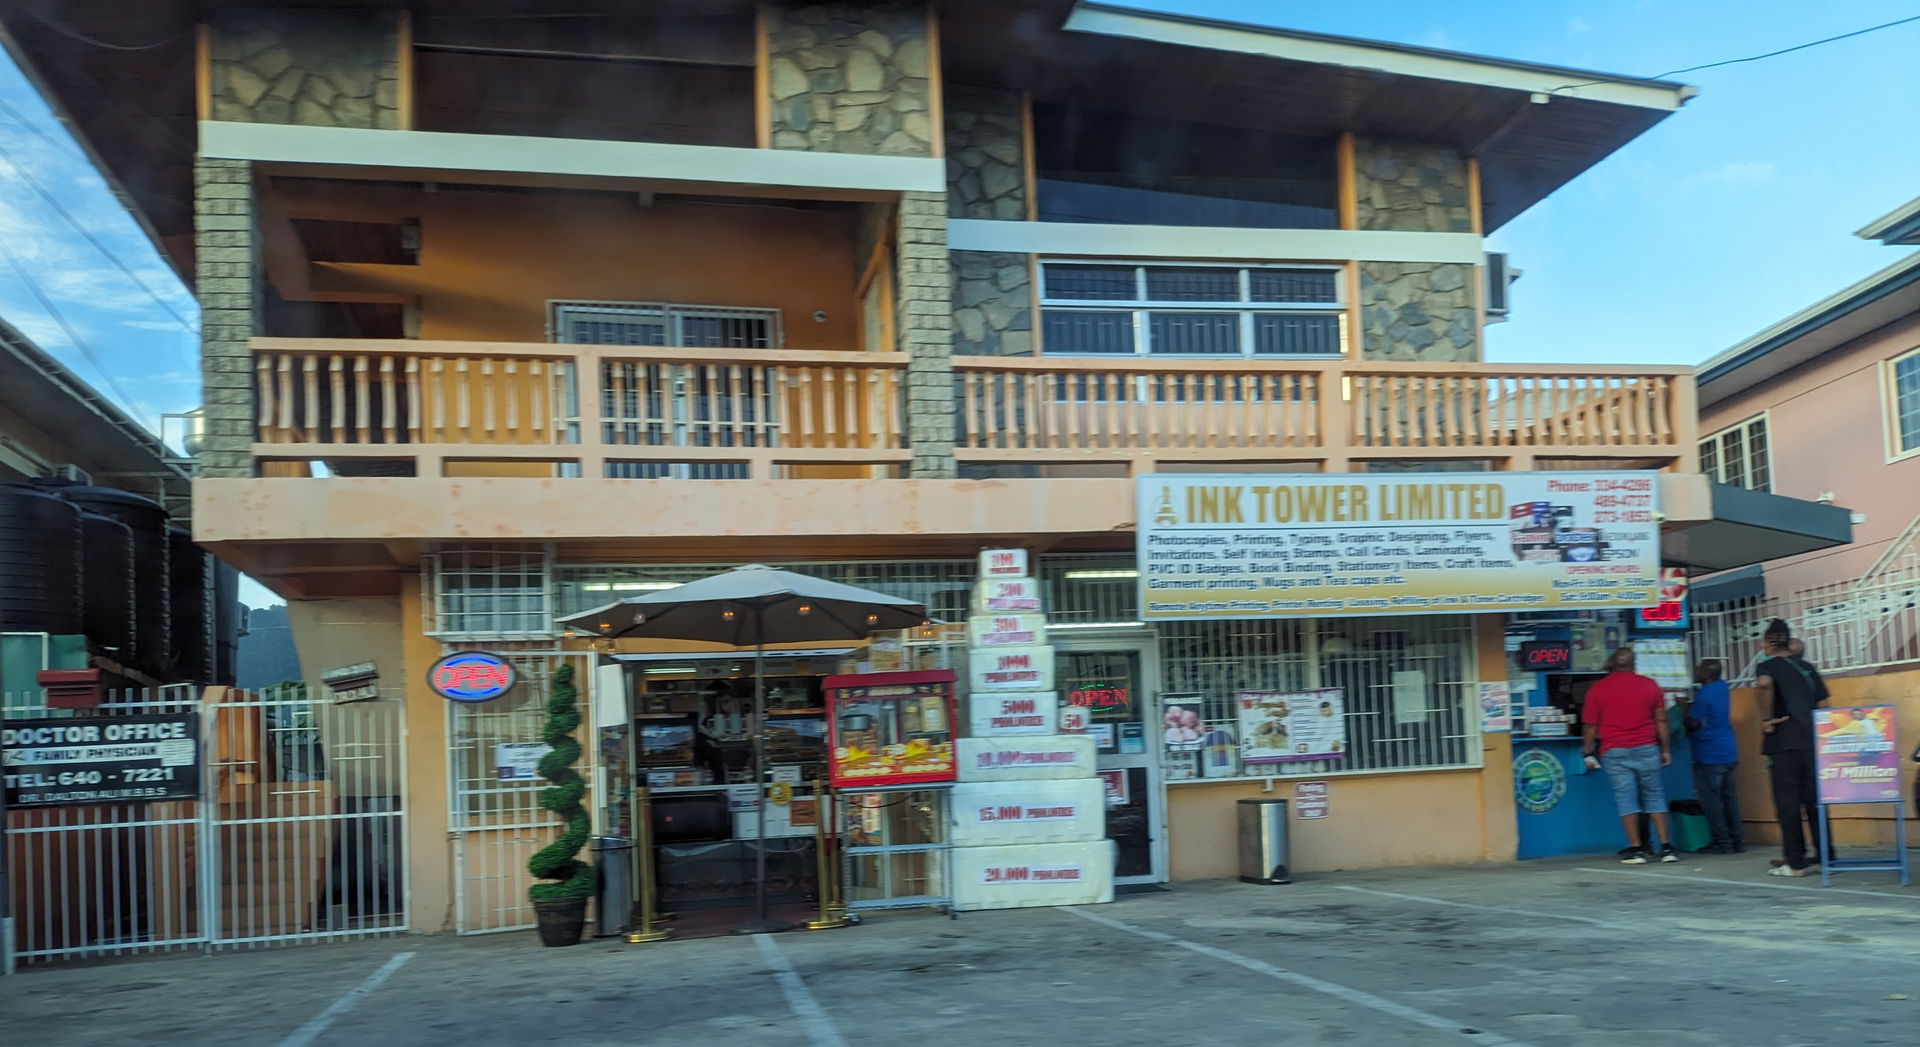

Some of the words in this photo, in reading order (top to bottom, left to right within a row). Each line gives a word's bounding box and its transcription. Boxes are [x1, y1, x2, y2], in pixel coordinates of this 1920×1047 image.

[1548, 480, 1590, 492] Phone:
[1186, 485, 1245, 524] INK
[1252, 484, 1369, 524] TOWER
[1379, 483, 1504, 521] LIMITED
[1149, 534, 1230, 546] Photocopies,
[1233, 534, 1285, 547] Printing,
[1289, 534, 1332, 546] Typing,
[1337, 533, 1384, 545] Graphic
[1389, 531, 1450, 545] Designing,
[1454, 530, 1495, 543] Flyers,
[1149, 549, 1218, 560] Invitations,
[1222, 549, 1248, 559] Self
[1251, 549, 1288, 561] Inking
[1293, 548, 1341, 560] Stamps,
[1345, 546, 1368, 557] Call
[1373, 546, 1411, 557] Cards,
[1414, 545, 1486, 557] Laminating,
[1148, 564, 1175, 575] PVC
[1178, 564, 1192, 574] ID
[1195, 564, 1245, 576] Badges,
[1249, 563, 1279, 573] Book
[1284, 562, 1332, 574] Binding,
[1337, 561, 1401, 572] Stationery
[1444, 559, 1474, 569] Craft
[1149, 579, 1204, 590] Garment
[1207, 578, 1259, 590] printing,
[1262, 577, 1296, 589] Mugs
[1299, 577, 1321, 587] and
[1326, 576, 1348, 586] Tea
[1351, 576, 1380, 588] cups
[1383, 575, 1407, 585] etc.
[998, 583, 1024, 598] 200
[993, 617, 1019, 632] 300
[1528, 649, 1569, 662] OPEN
[433, 664, 510, 690] OPEN
[1068, 689, 1128, 706] OPEN
[1001, 700, 1036, 715] 5000
[1065, 714, 1083, 728] 50
[1, 725, 101, 745] DOCTOR
[104, 723, 186, 741] OFFICE
[33, 750, 81, 761] FAMILY
[86, 747, 157, 760] PHYSICIAN
[121, 767, 174, 782] 7221
[1840, 765, 1898, 779] Million
